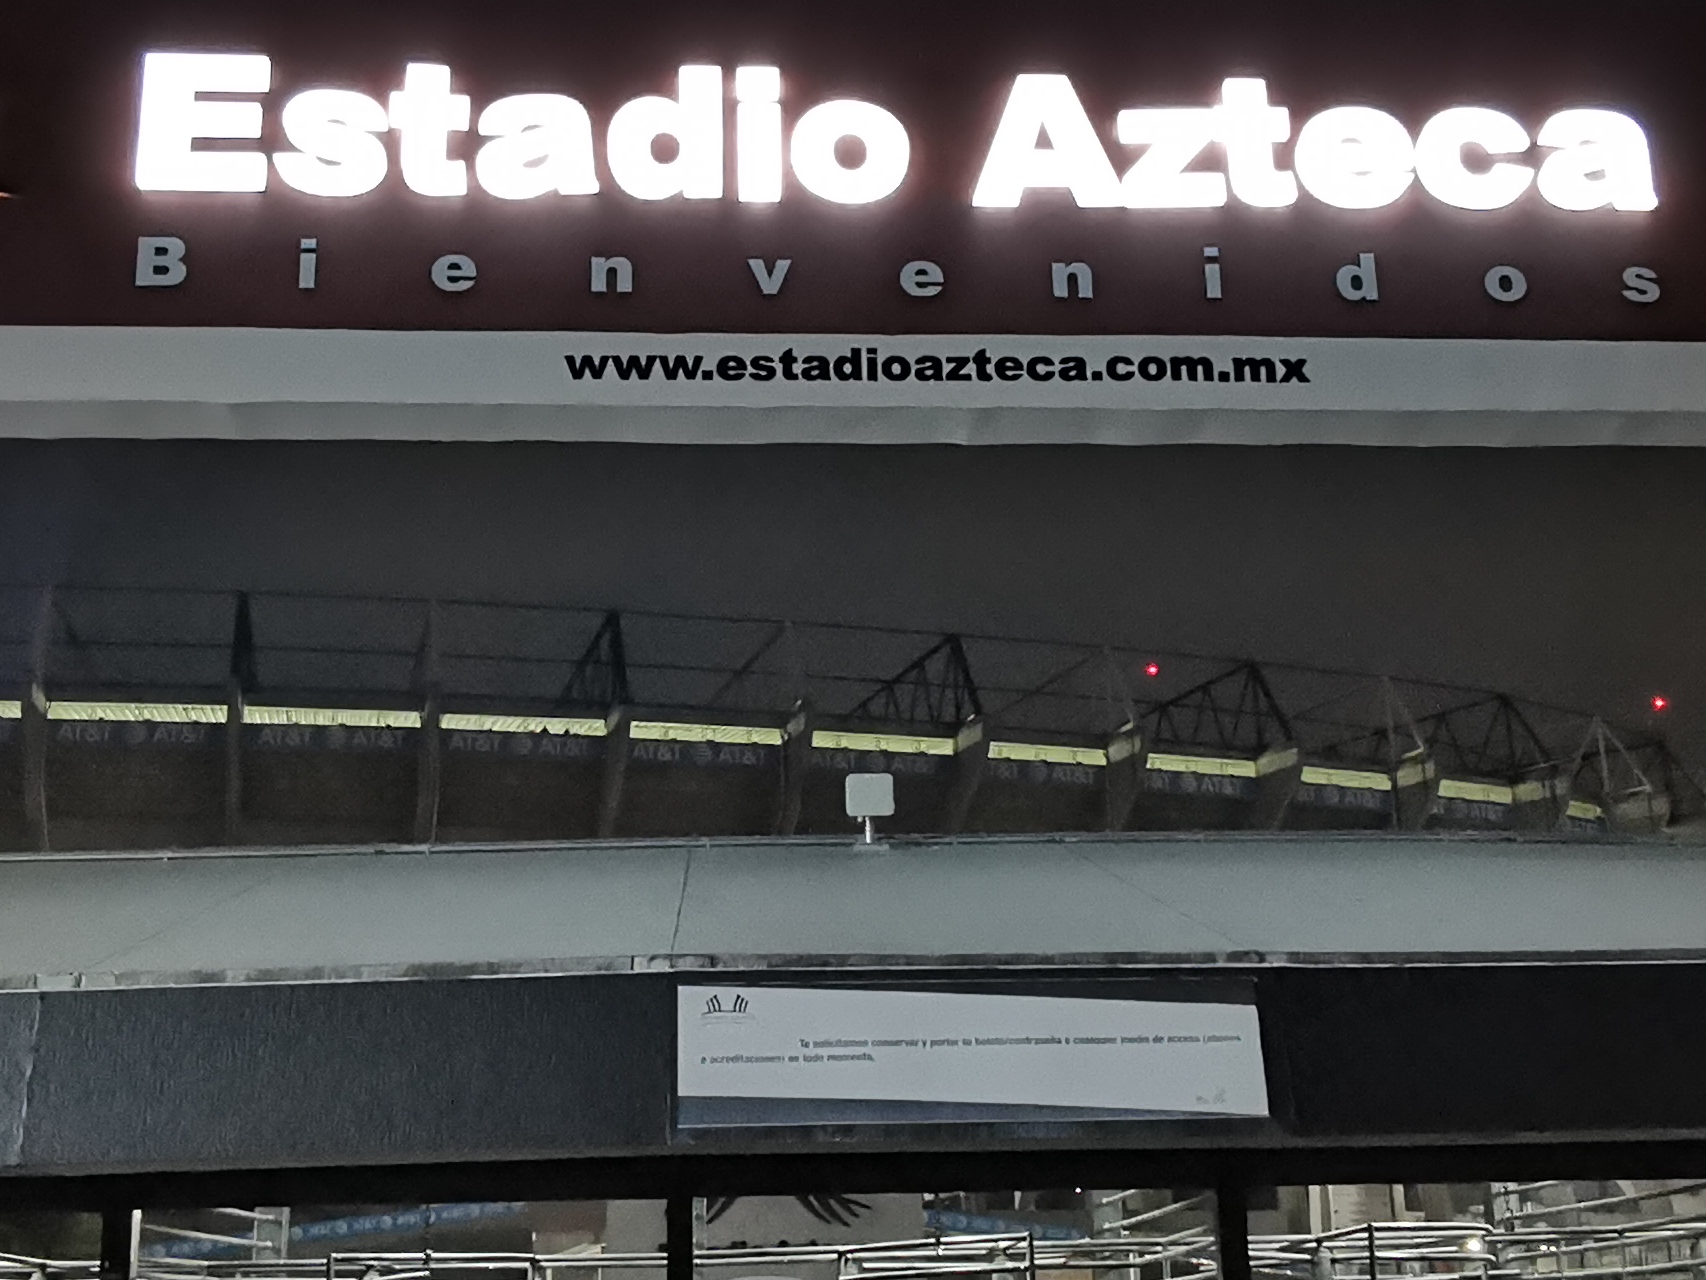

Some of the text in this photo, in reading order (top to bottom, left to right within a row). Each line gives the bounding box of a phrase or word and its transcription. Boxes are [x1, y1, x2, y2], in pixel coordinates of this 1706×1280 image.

[134, 51, 1660, 212] Estadio Azteca
[134, 236, 1662, 304] Bienvenidos
[564, 345, 1311, 385] www.estadioazteca.com.mx
